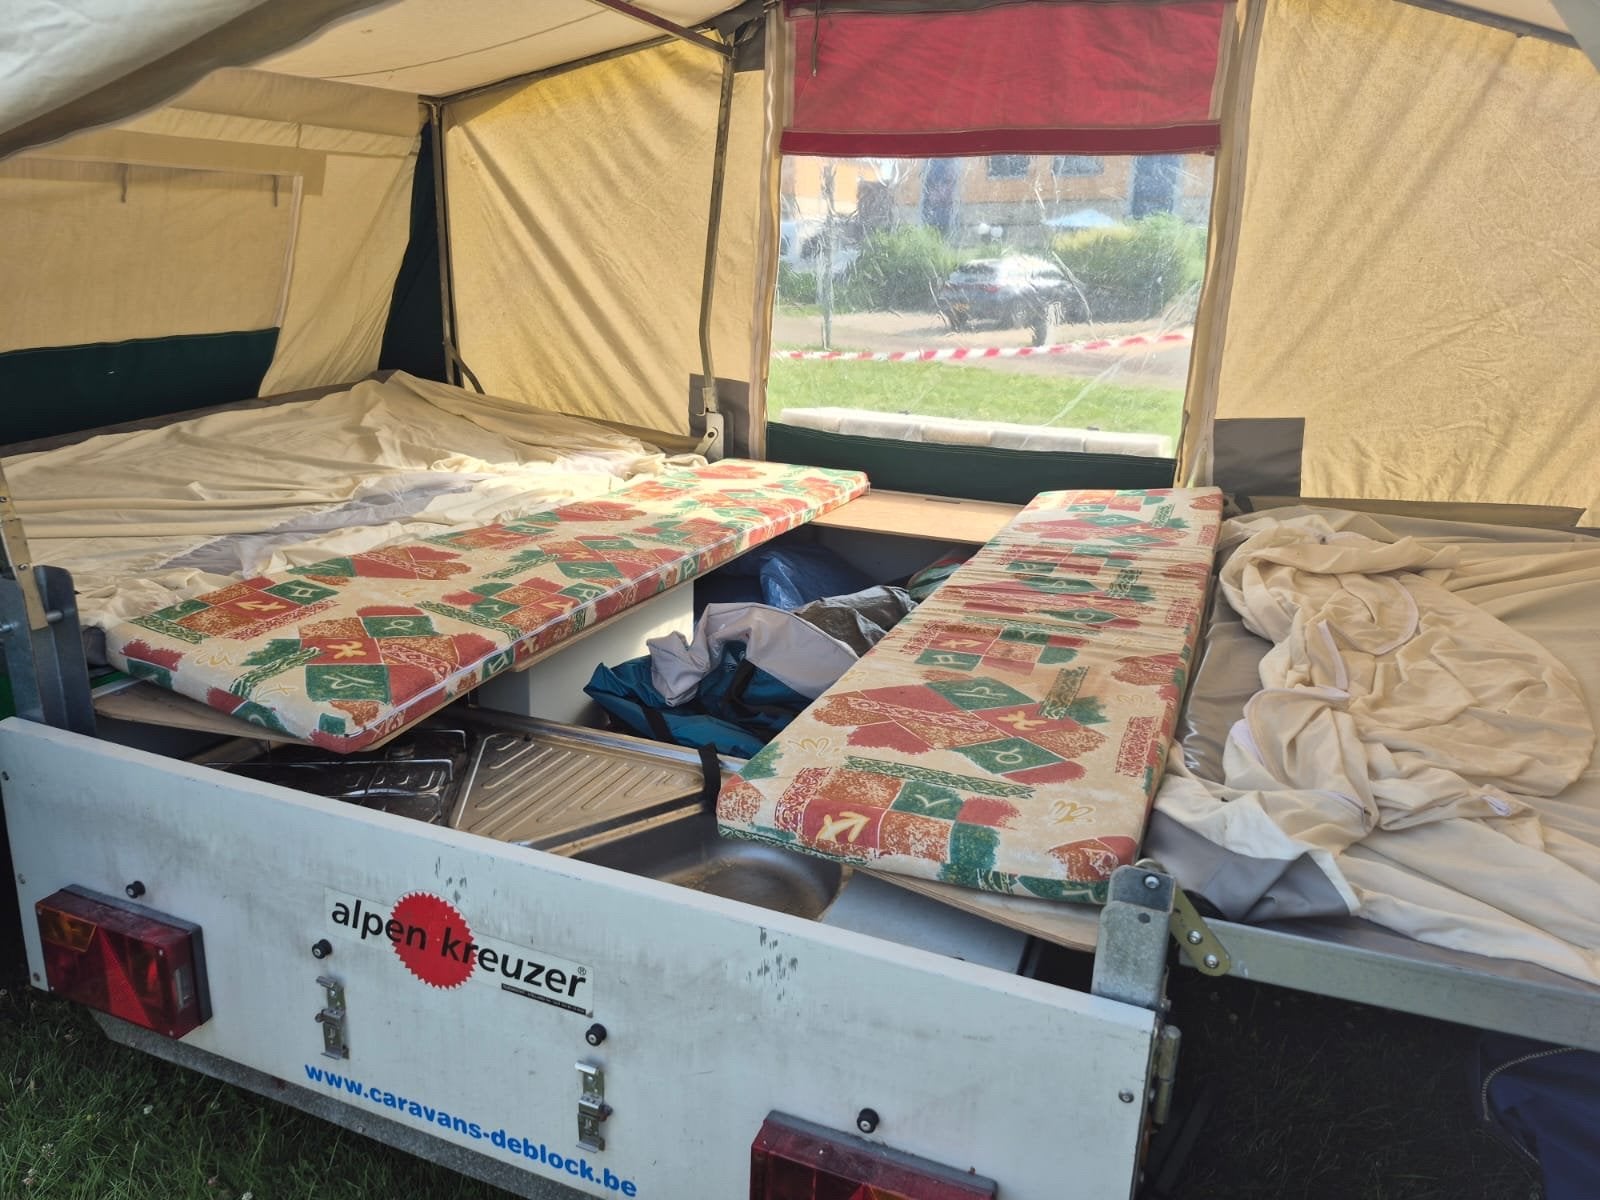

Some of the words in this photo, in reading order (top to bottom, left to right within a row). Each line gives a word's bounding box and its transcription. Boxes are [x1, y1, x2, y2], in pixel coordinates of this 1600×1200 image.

[331, 900, 427, 950] alpen
[440, 927, 586, 998] kreuzer
[304, 1064, 638, 1197] www.caravans-deblock.be
